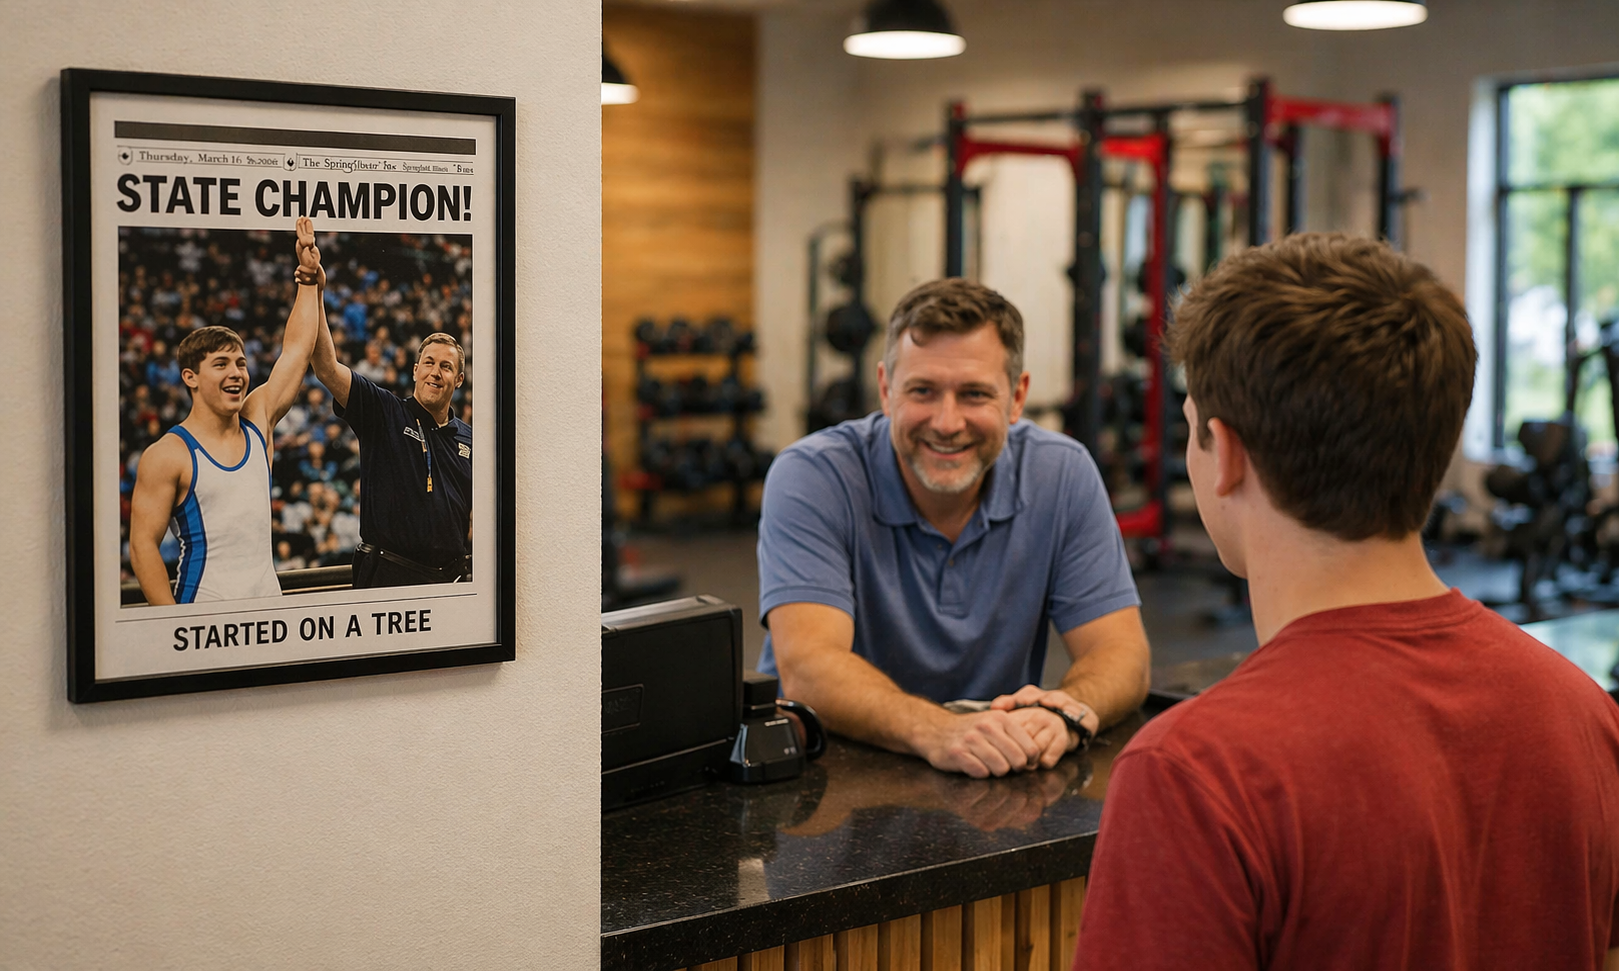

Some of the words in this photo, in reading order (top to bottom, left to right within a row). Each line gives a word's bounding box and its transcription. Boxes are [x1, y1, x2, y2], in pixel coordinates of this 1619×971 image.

[139, 151, 193, 164] Thursday,
[198, 153, 229, 164] March
[302, 157, 321, 168] The
[116, 173, 241, 216] STATE
[254, 178, 473, 222] CHAMPION!
[173, 619, 288, 652] STARTED
[299, 616, 335, 641] ON
[345, 614, 363, 638] A
[371, 609, 432, 635] TREE
